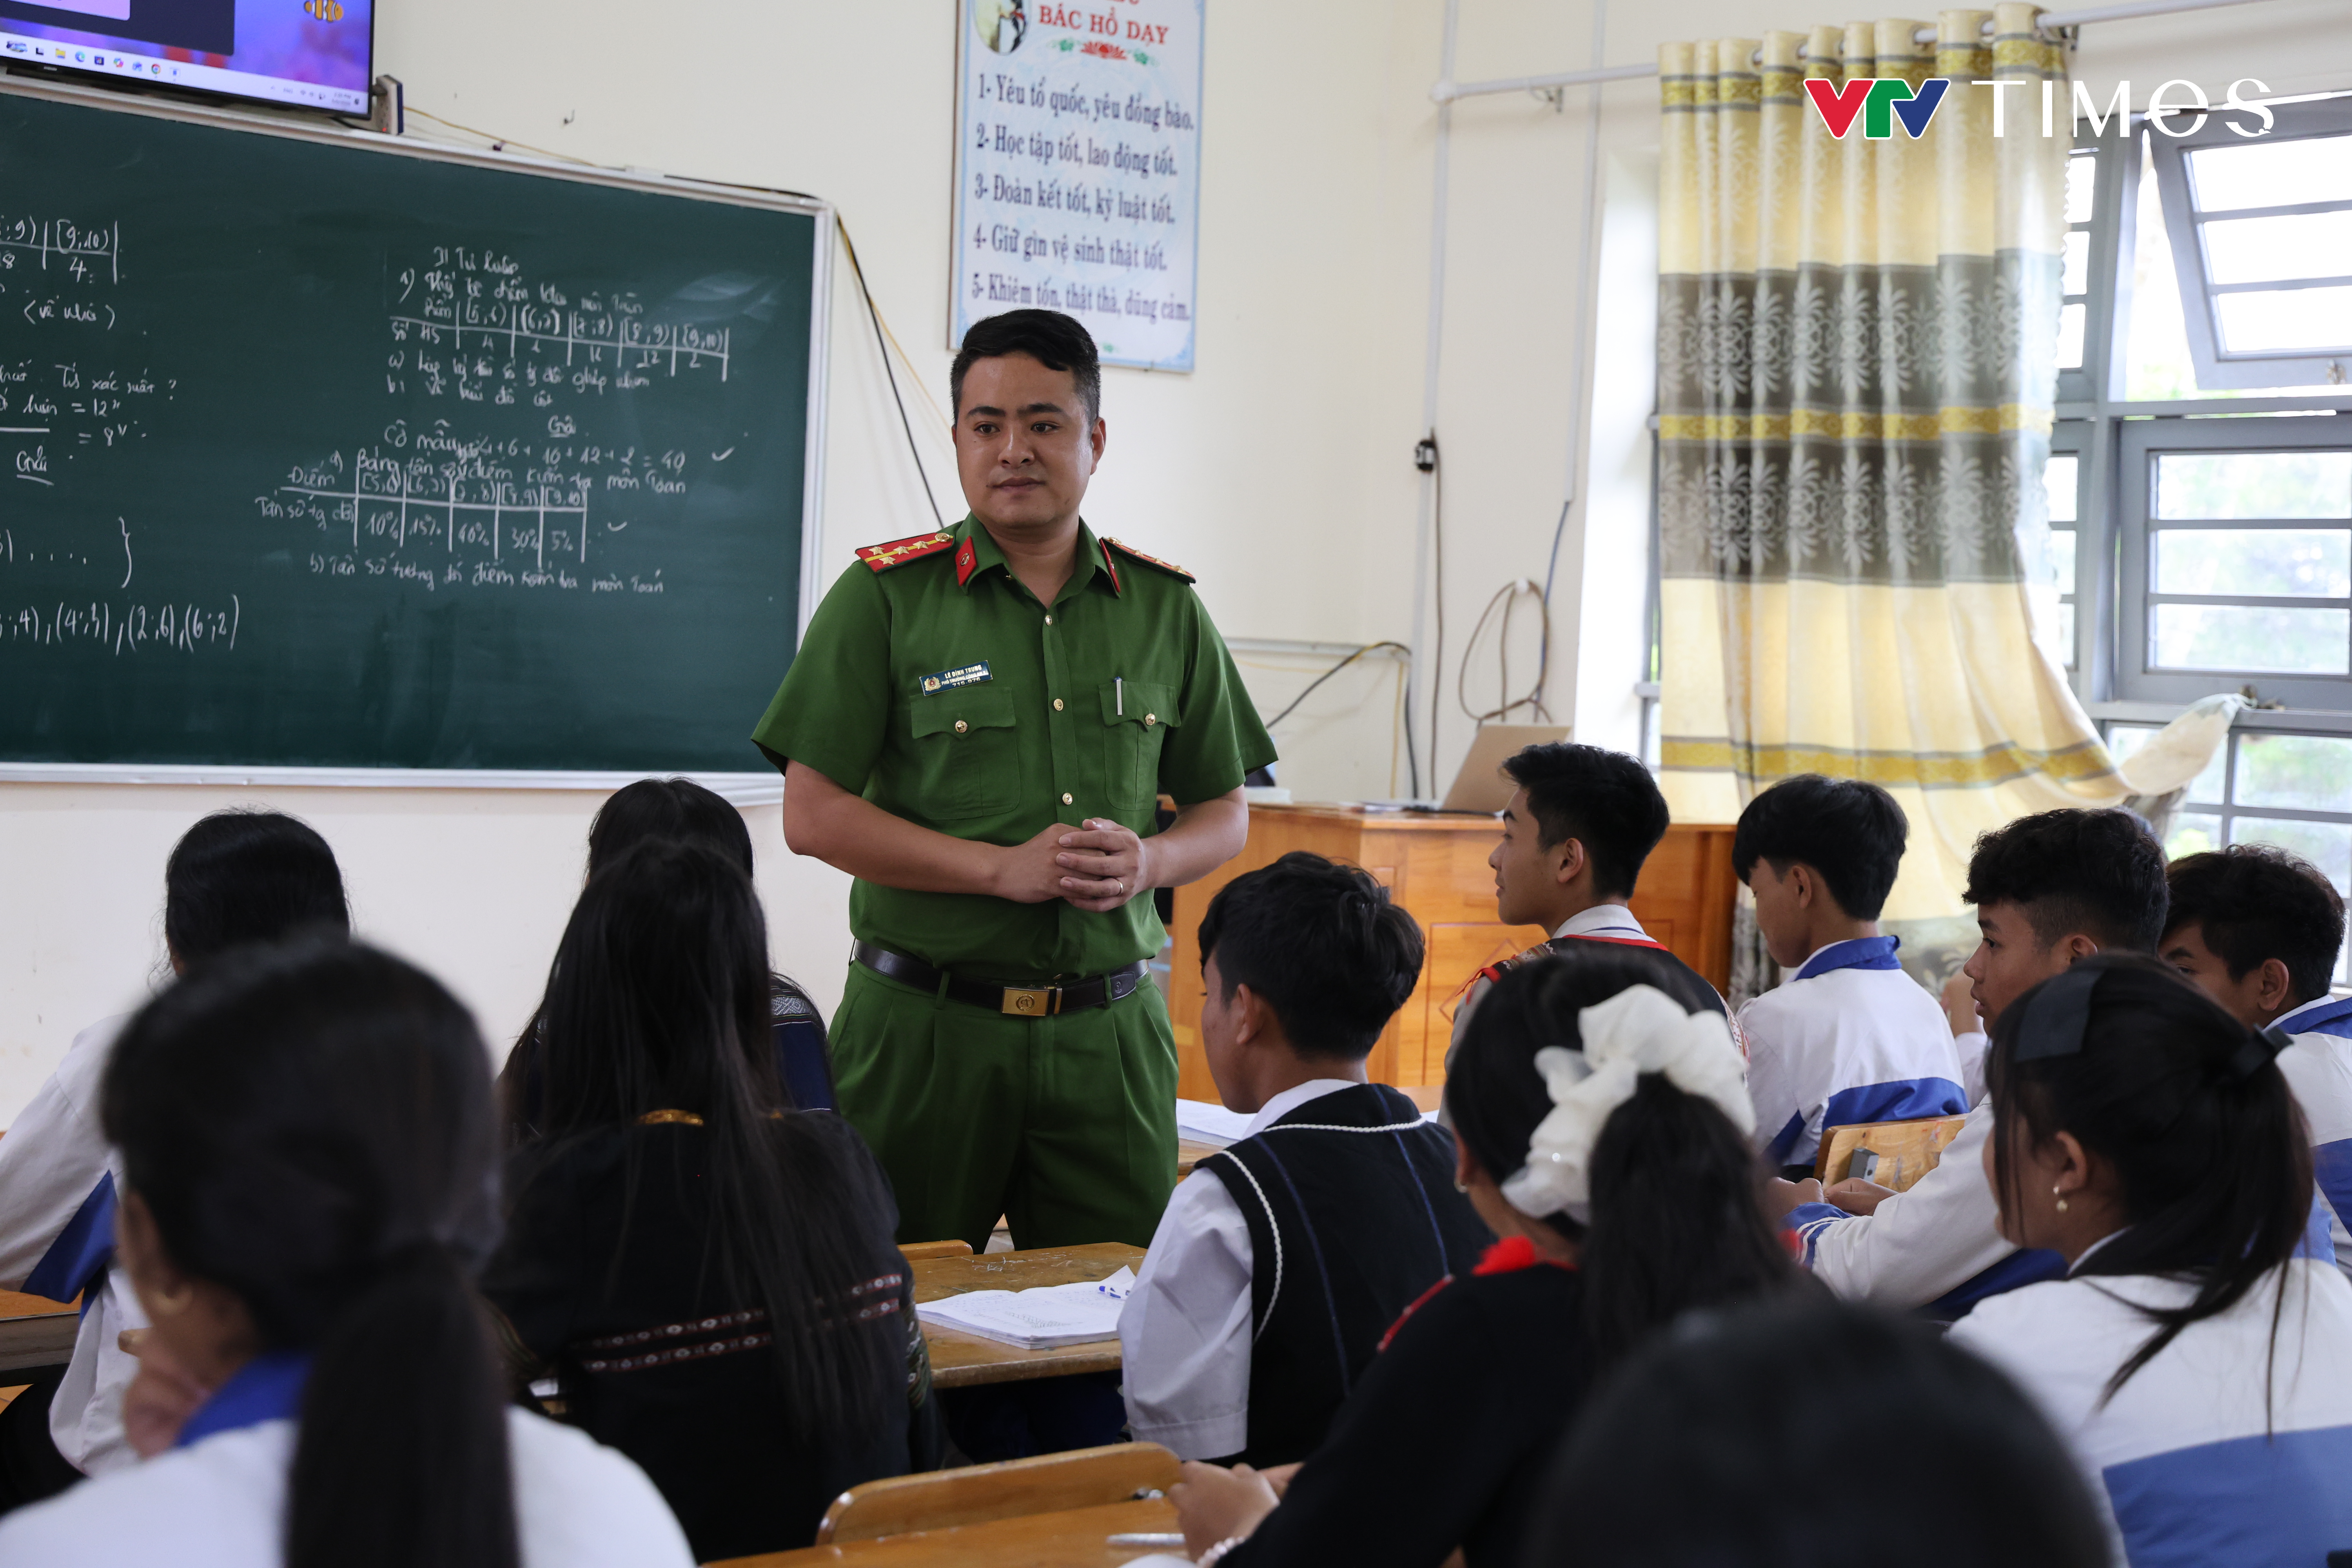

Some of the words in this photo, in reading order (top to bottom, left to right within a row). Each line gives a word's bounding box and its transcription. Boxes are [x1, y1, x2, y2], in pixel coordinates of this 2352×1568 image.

[1040, 3, 1082, 30] BÁC
[1127, 20, 1169, 46] DẠY
[996, 74, 1025, 104] Yêu
[1050, 82, 1089, 119] quốc,
[1093, 92, 1120, 122] yêu
[995, 125, 1025, 160] Học
[1030, 131, 1054, 165] tập
[1059, 131, 1083, 167] tốt,
[1088, 138, 1109, 167] lao
[1114, 142, 1150, 179] động
[994, 173, 1032, 205] Đoàn
[1038, 178, 1061, 209] kết
[1067, 182, 1091, 218] tốt,
[1119, 191, 1146, 225] luật
[992, 223, 1020, 252] Giữ
[1024, 230, 1047, 262] gìn
[1053, 234, 1068, 265] vệ
[1074, 236, 1104, 263] sinh
[1111, 239, 1138, 272] thật
[989, 273, 1031, 304] Khiêm
[1067, 282, 1092, 314] thật
[965, 665, 982, 673] TRUNG
